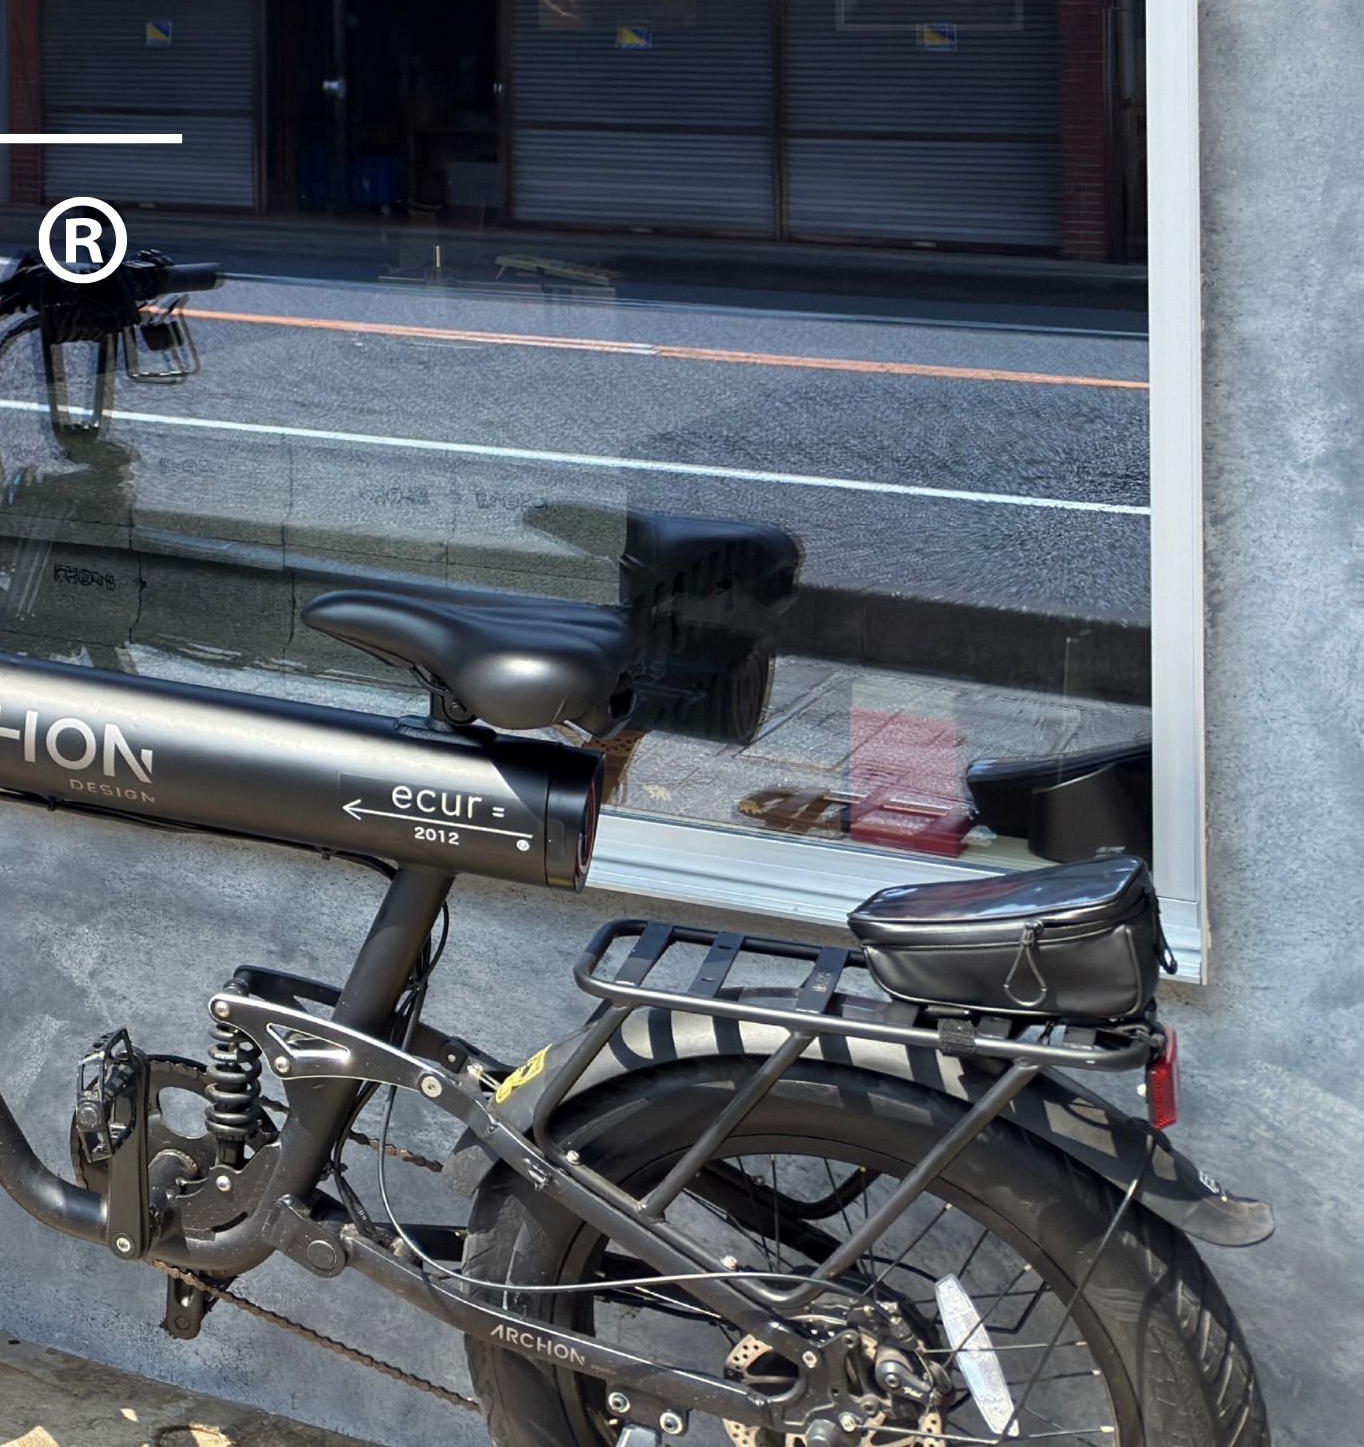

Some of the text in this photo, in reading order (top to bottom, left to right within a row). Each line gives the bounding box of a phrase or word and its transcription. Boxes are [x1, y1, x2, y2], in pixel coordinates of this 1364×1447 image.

[70, 778, 156, 804] DESIGN
[391, 784, 483, 820] ecur
[414, 826, 460, 846] 2012
[490, 1324, 586, 1366] ARCHON
